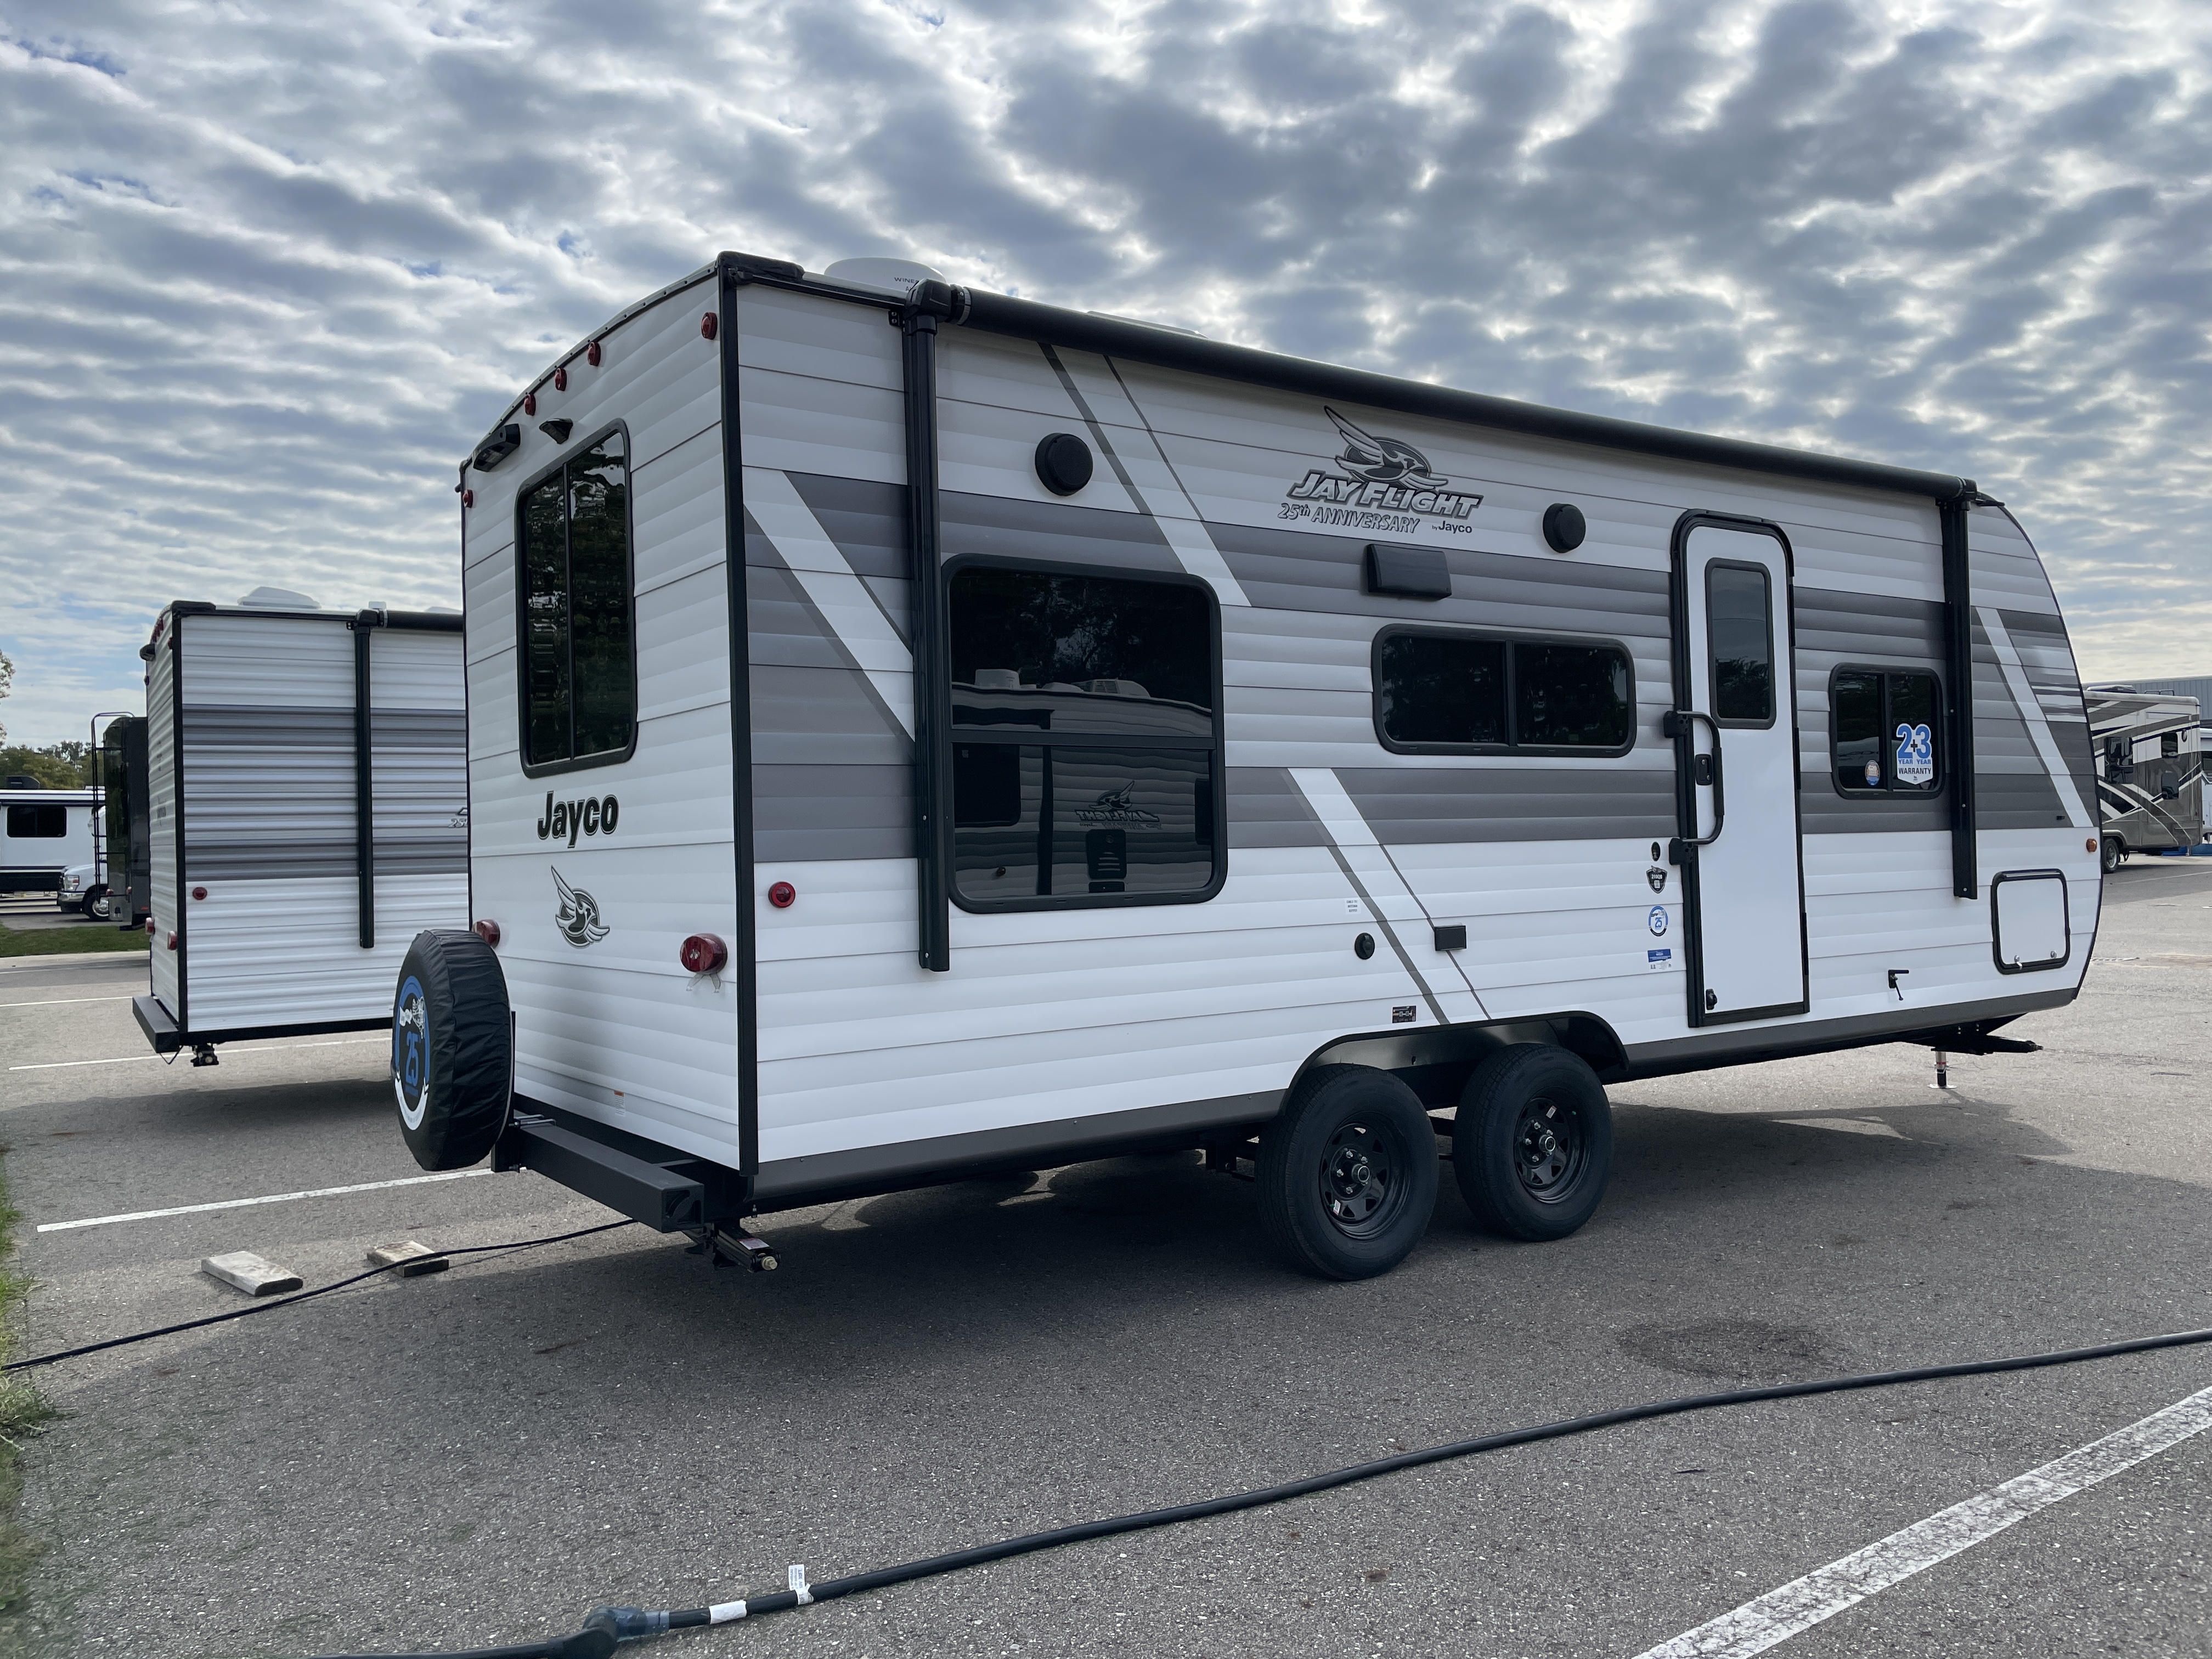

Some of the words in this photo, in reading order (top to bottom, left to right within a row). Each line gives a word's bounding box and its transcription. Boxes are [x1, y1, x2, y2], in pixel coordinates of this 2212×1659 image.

[1277, 503, 1310, 520] 25th
[1311, 506, 1420, 533] ANNIVERSARY
[1438, 520, 1472, 534] Jayco
[537, 791, 619, 848] Jayco
[1655, 917, 1662, 928] 25
[405, 1031, 419, 1087] 25
